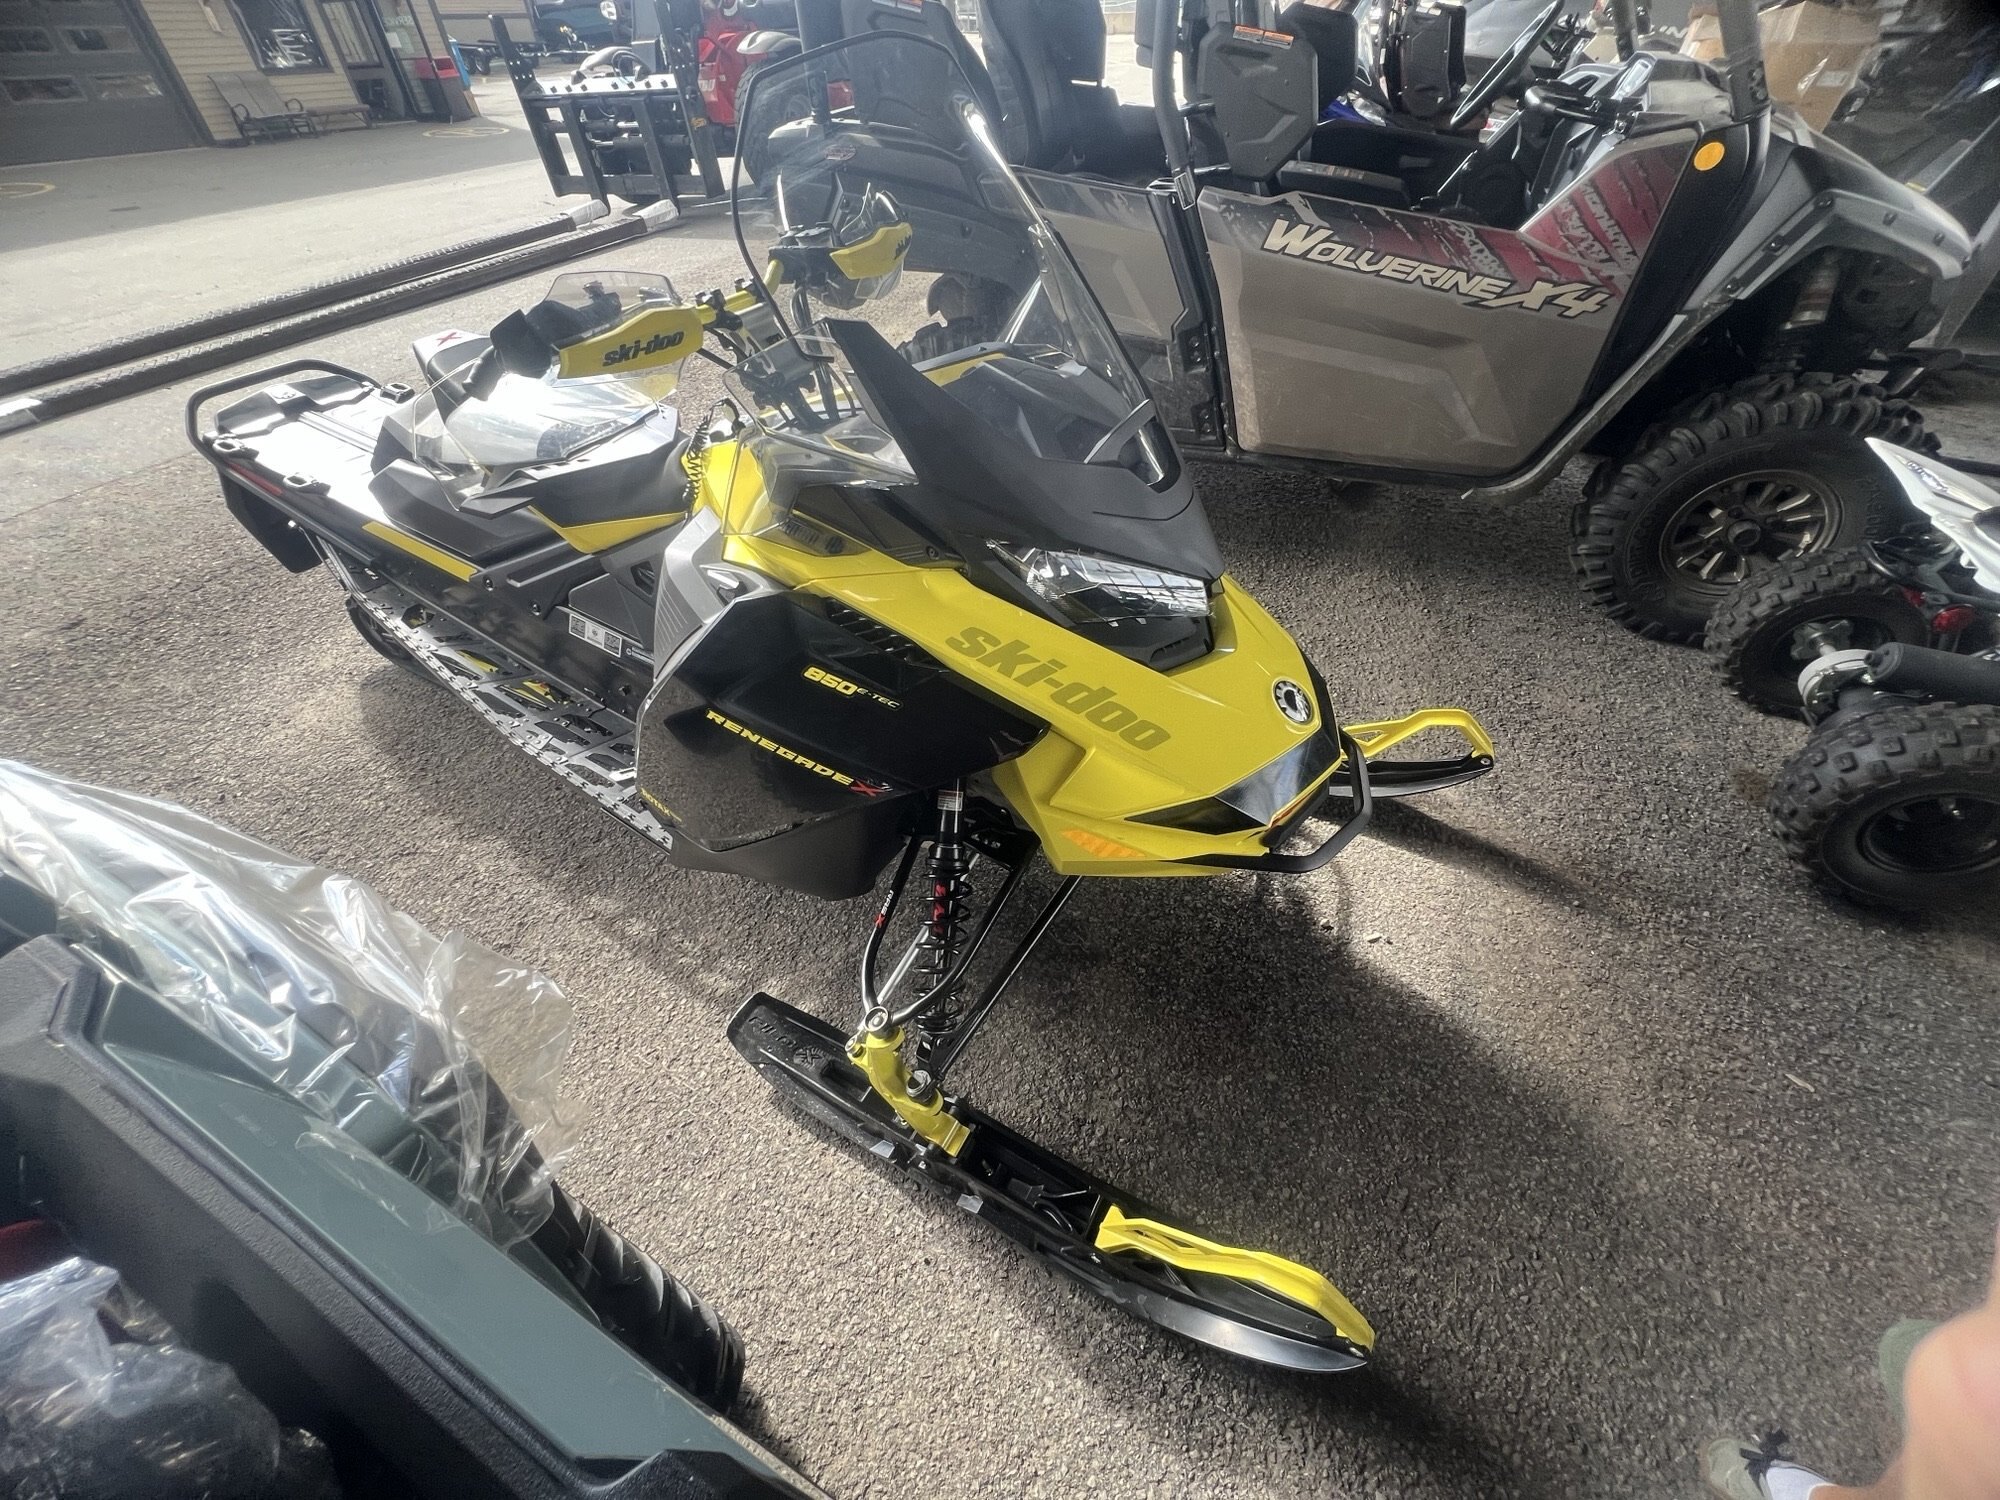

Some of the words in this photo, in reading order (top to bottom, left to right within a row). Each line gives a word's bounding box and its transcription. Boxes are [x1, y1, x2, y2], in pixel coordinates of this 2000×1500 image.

[1261, 217, 1513, 300] WOLVERINE
[1478, 279, 1612, 319] X4
[602, 331, 684, 367] ski-doo
[803, 666, 858, 695] 850
[945, 626, 1172, 751] ski-doo
[706, 709, 854, 786] RENEGADE
